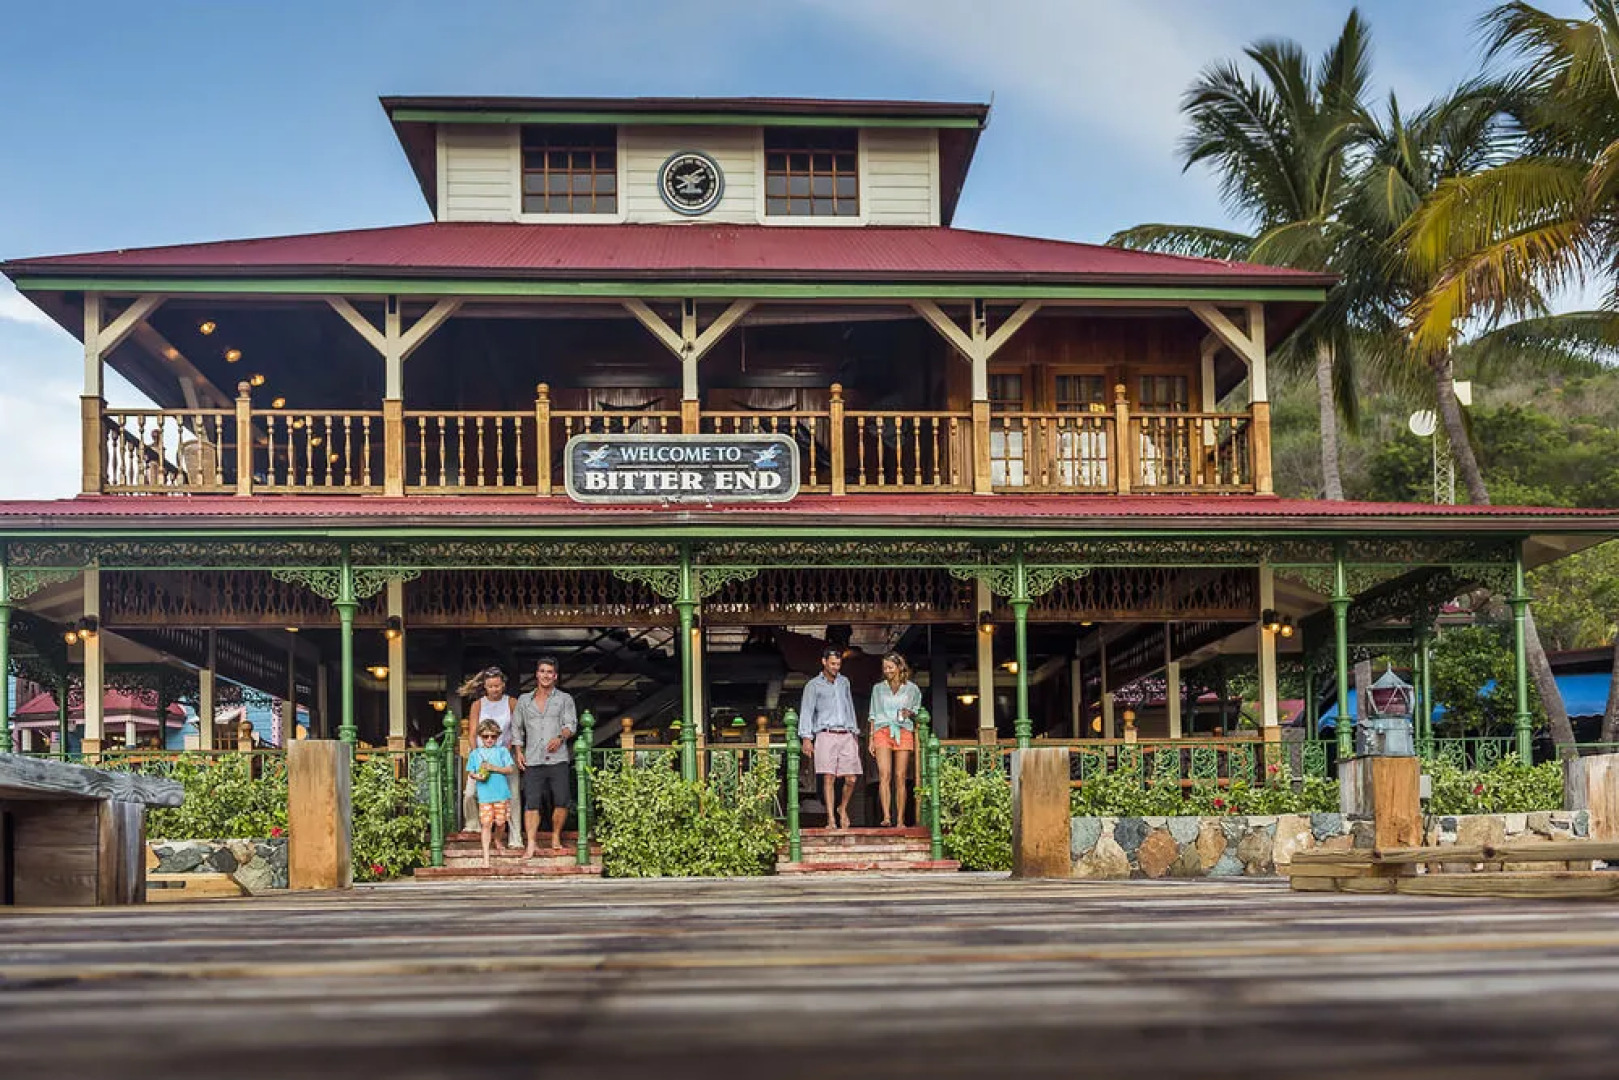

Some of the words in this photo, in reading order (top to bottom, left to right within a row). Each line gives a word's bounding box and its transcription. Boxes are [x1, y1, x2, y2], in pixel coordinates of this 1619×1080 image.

[619, 446, 712, 462] WELCOME
[714, 446, 741, 462] TO
[584, 471, 703, 490] BITTER
[714, 471, 782, 490] END
